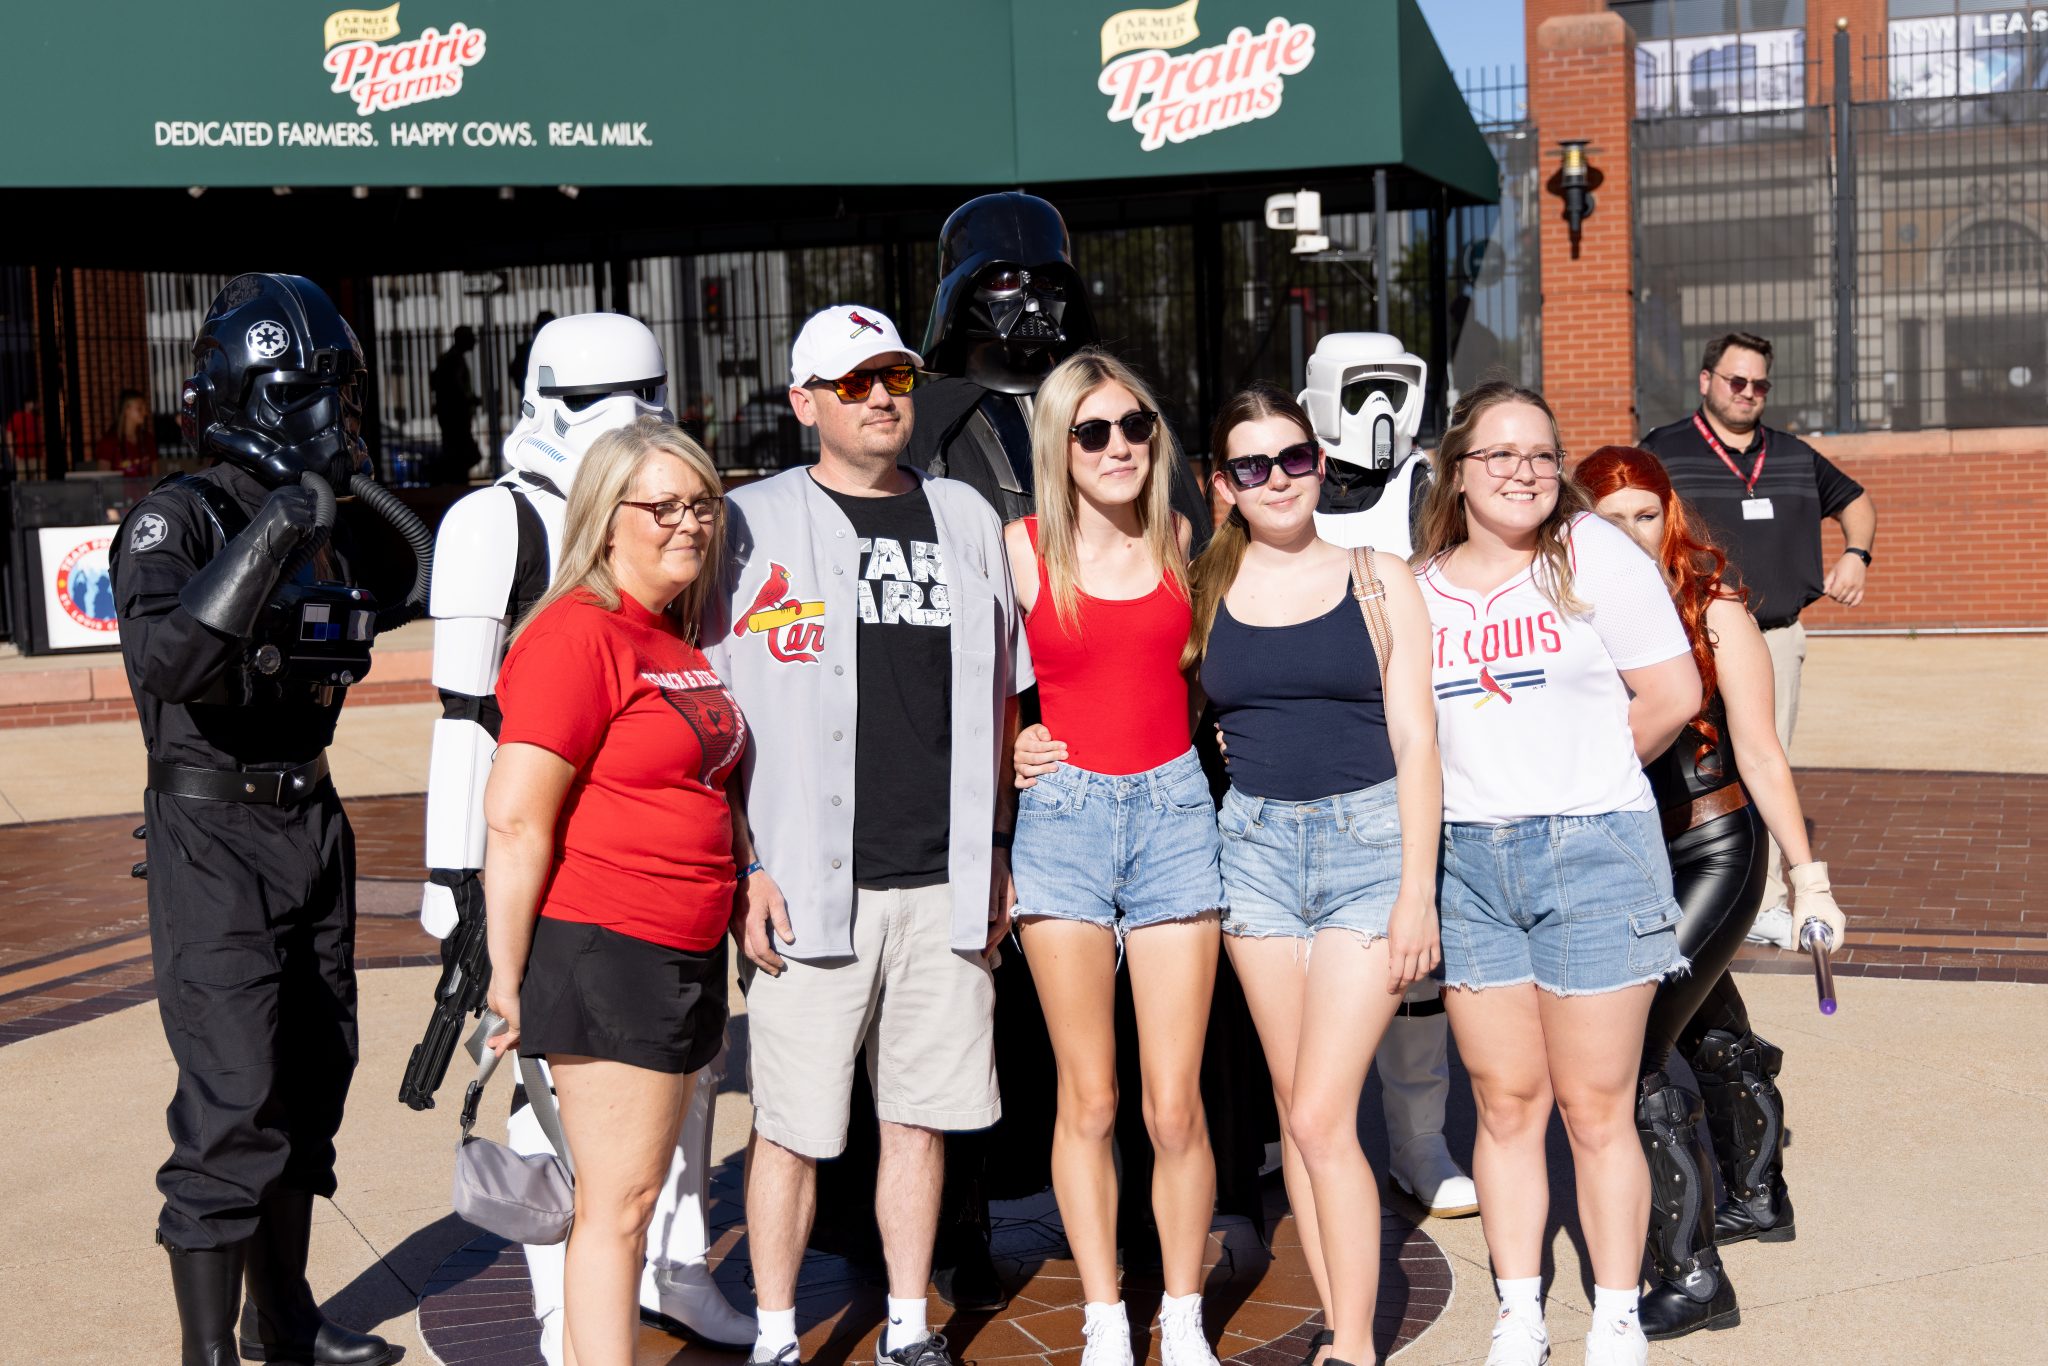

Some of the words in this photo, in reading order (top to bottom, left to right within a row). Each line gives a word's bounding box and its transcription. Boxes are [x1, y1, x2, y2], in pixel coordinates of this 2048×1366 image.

[1114, 13, 1187, 34] FARMER
[1118, 27, 1185, 46] OWNED
[1893, 18, 1956, 41] NOW
[328, 27, 481, 86] Prairie
[1105, 22, 1309, 112] Prairie
[356, 70, 458, 109] Farms
[1140, 82, 1277, 141] Farms
[154, 121, 273, 147] DEDICATED
[277, 121, 379, 147] FARMERS.
[390, 121, 458, 147] HAPPY
[462, 121, 538, 147] COWS.
[547, 121, 599, 147] REAL
[601, 121, 653, 147] MILK.
[1463, 610, 1562, 665] LOUIS
[641, 672, 688, 690] TRACK
